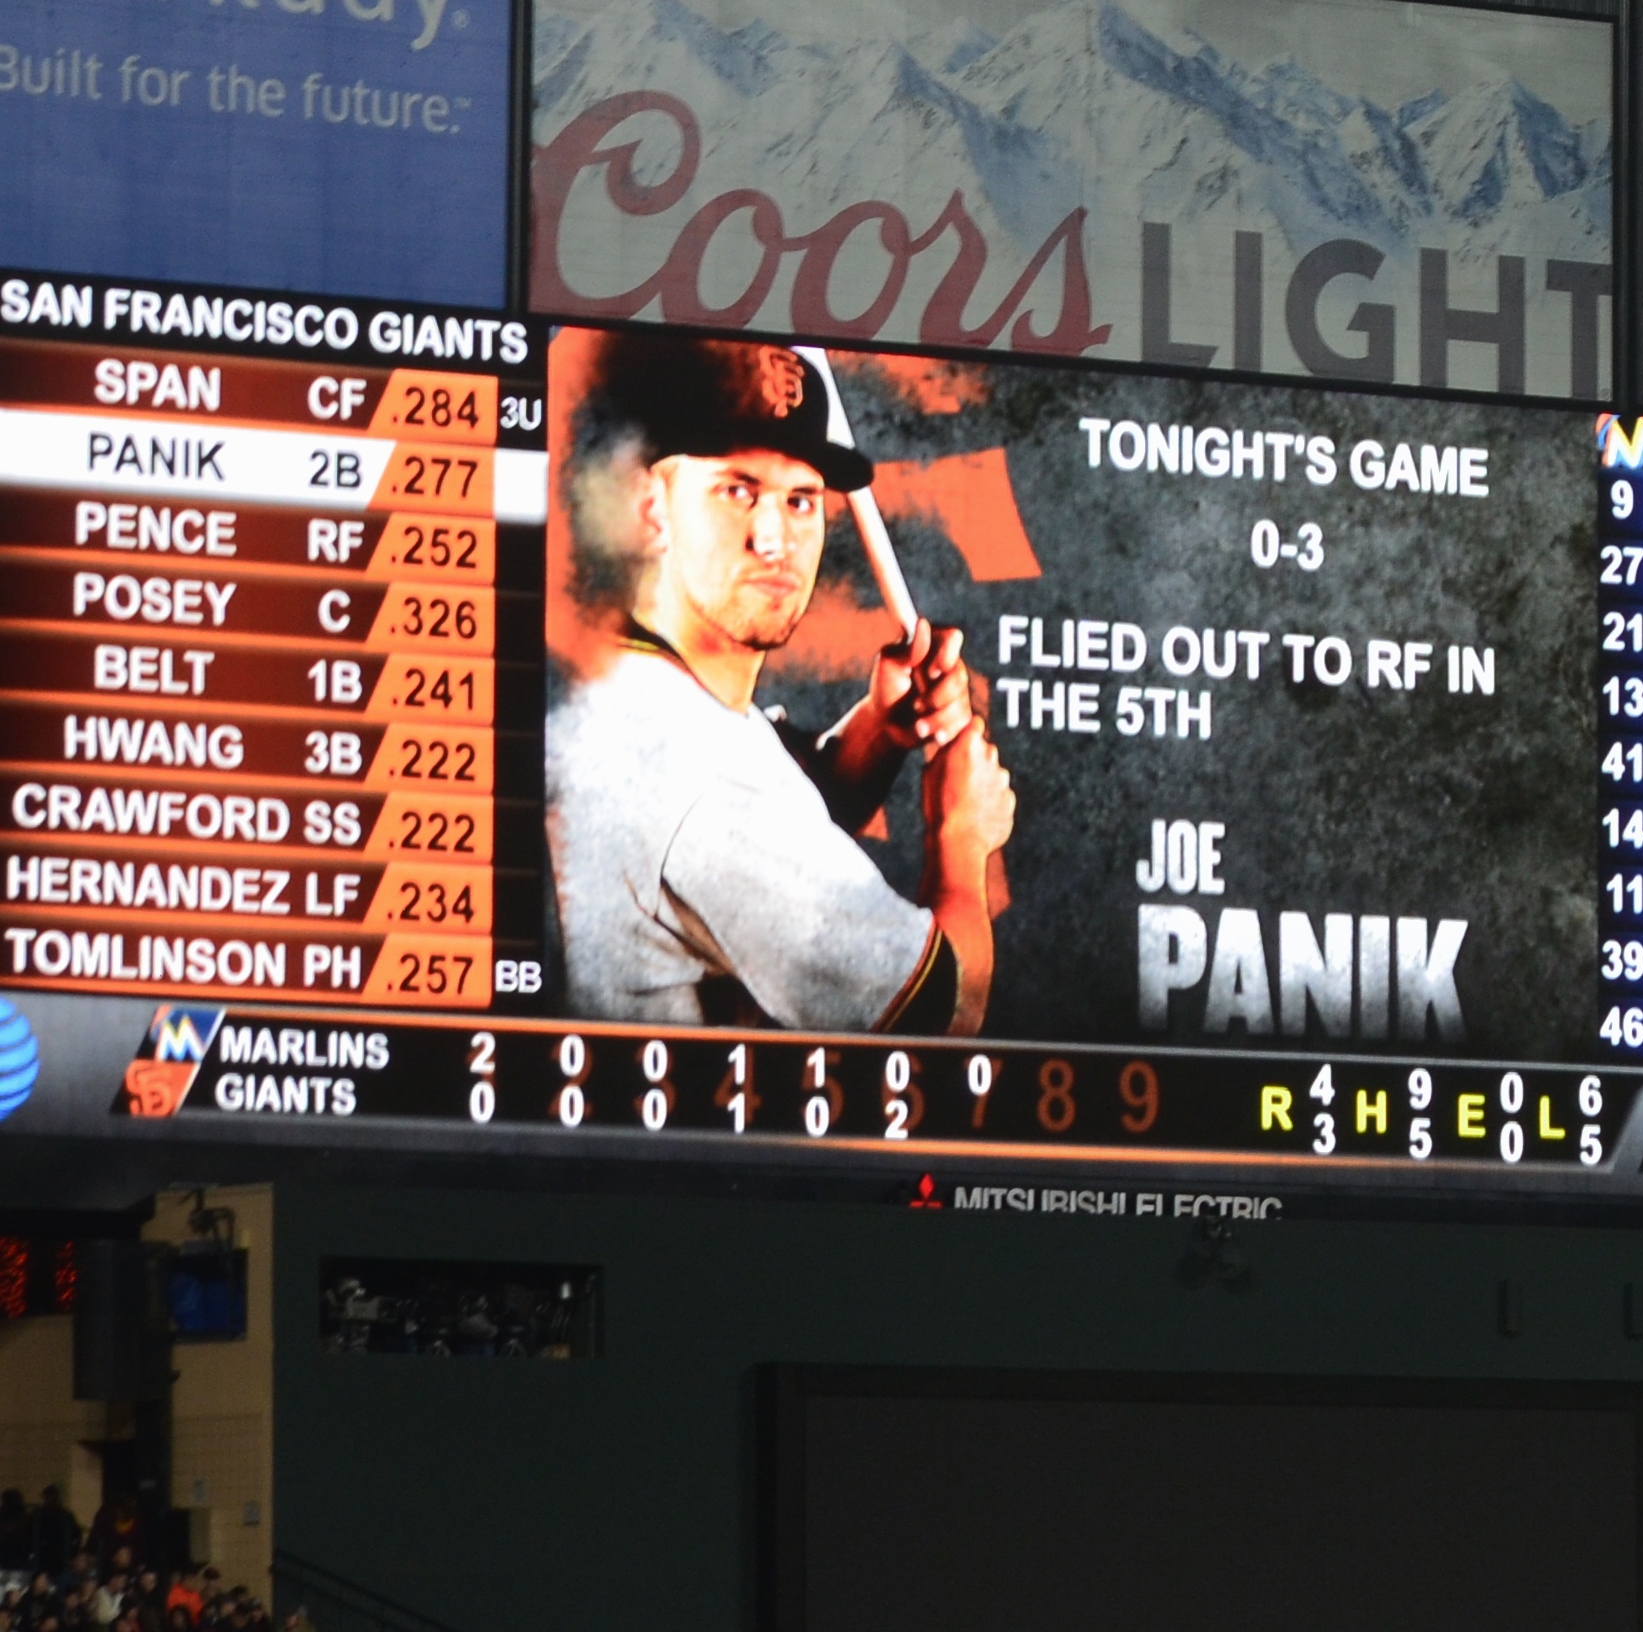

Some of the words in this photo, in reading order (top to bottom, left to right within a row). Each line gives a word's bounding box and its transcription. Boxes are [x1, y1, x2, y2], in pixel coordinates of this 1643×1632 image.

[0, 45, 102, 101] Built
[118, 55, 190, 106] for
[207, 64, 286, 117] the
[302, 73, 460, 134] future.
[527, 89, 1113, 358] Coors
[1141, 223, 1612, 401] LIGHT
[0, 279, 93, 327] SAN
[104, 288, 359, 349] FRANCISCO
[369, 311, 528, 364] GIANTS
[94, 359, 221, 410] SPAN
[307, 376, 367, 420] CF
[391, 386, 480, 428] .284
[500, 397, 543, 431] 3U
[88, 431, 226, 481] PANIK
[309, 450, 363, 489] 2B
[391, 455, 478, 498] .277
[1078, 416, 1337, 486] TONIGHT'S
[1349, 438, 1490, 498] GAME
[1611, 480, 1634, 519] 9
[74, 501, 237, 556] PENCE
[307, 519, 364, 563] RF
[390, 526, 478, 570] .252
[1250, 519, 1325, 570] 0-3
[1600, 546, 1643, 585] 27
[73, 573, 237, 627] POSEY
[318, 590, 351, 633] C
[389, 597, 478, 640] .326
[1602, 612, 1643, 652] 21
[94, 644, 215, 695] BELT
[307, 660, 363, 703] 1B
[391, 669, 476, 711] .241
[998, 614, 1148, 672] FLIED
[1161, 625, 1269, 679] OUT
[1282, 633, 1351, 686] TO
[1365, 639, 1431, 692] RF
[1446, 645, 1495, 697] IN
[998, 676, 1100, 732] THE
[1116, 685, 1212, 740] 5TH
[64, 714, 244, 769] HWANG
[304, 731, 363, 776] 3B
[388, 739, 476, 782] .222
[1601, 742, 1643, 782] 41
[11, 783, 291, 843] CRAWFORD
[303, 801, 362, 846] SS
[388, 810, 476, 854] .222
[5, 855, 291, 914] HERNANDEZ
[305, 873, 361, 917] LF
[387, 882, 476, 923] .234
[1134, 819, 1225, 895] JOE
[1606, 873, 1643, 914] 11
[4, 927, 286, 987] TOMLINSON
[303, 945, 362, 989] PH
[386, 952, 474, 995] .257
[495, 959, 543, 994] BB
[1136, 903, 1469, 1045] PANIK
[219, 1025, 389, 1069] MARLINS
[214, 1073, 357, 1116] GIANTS
